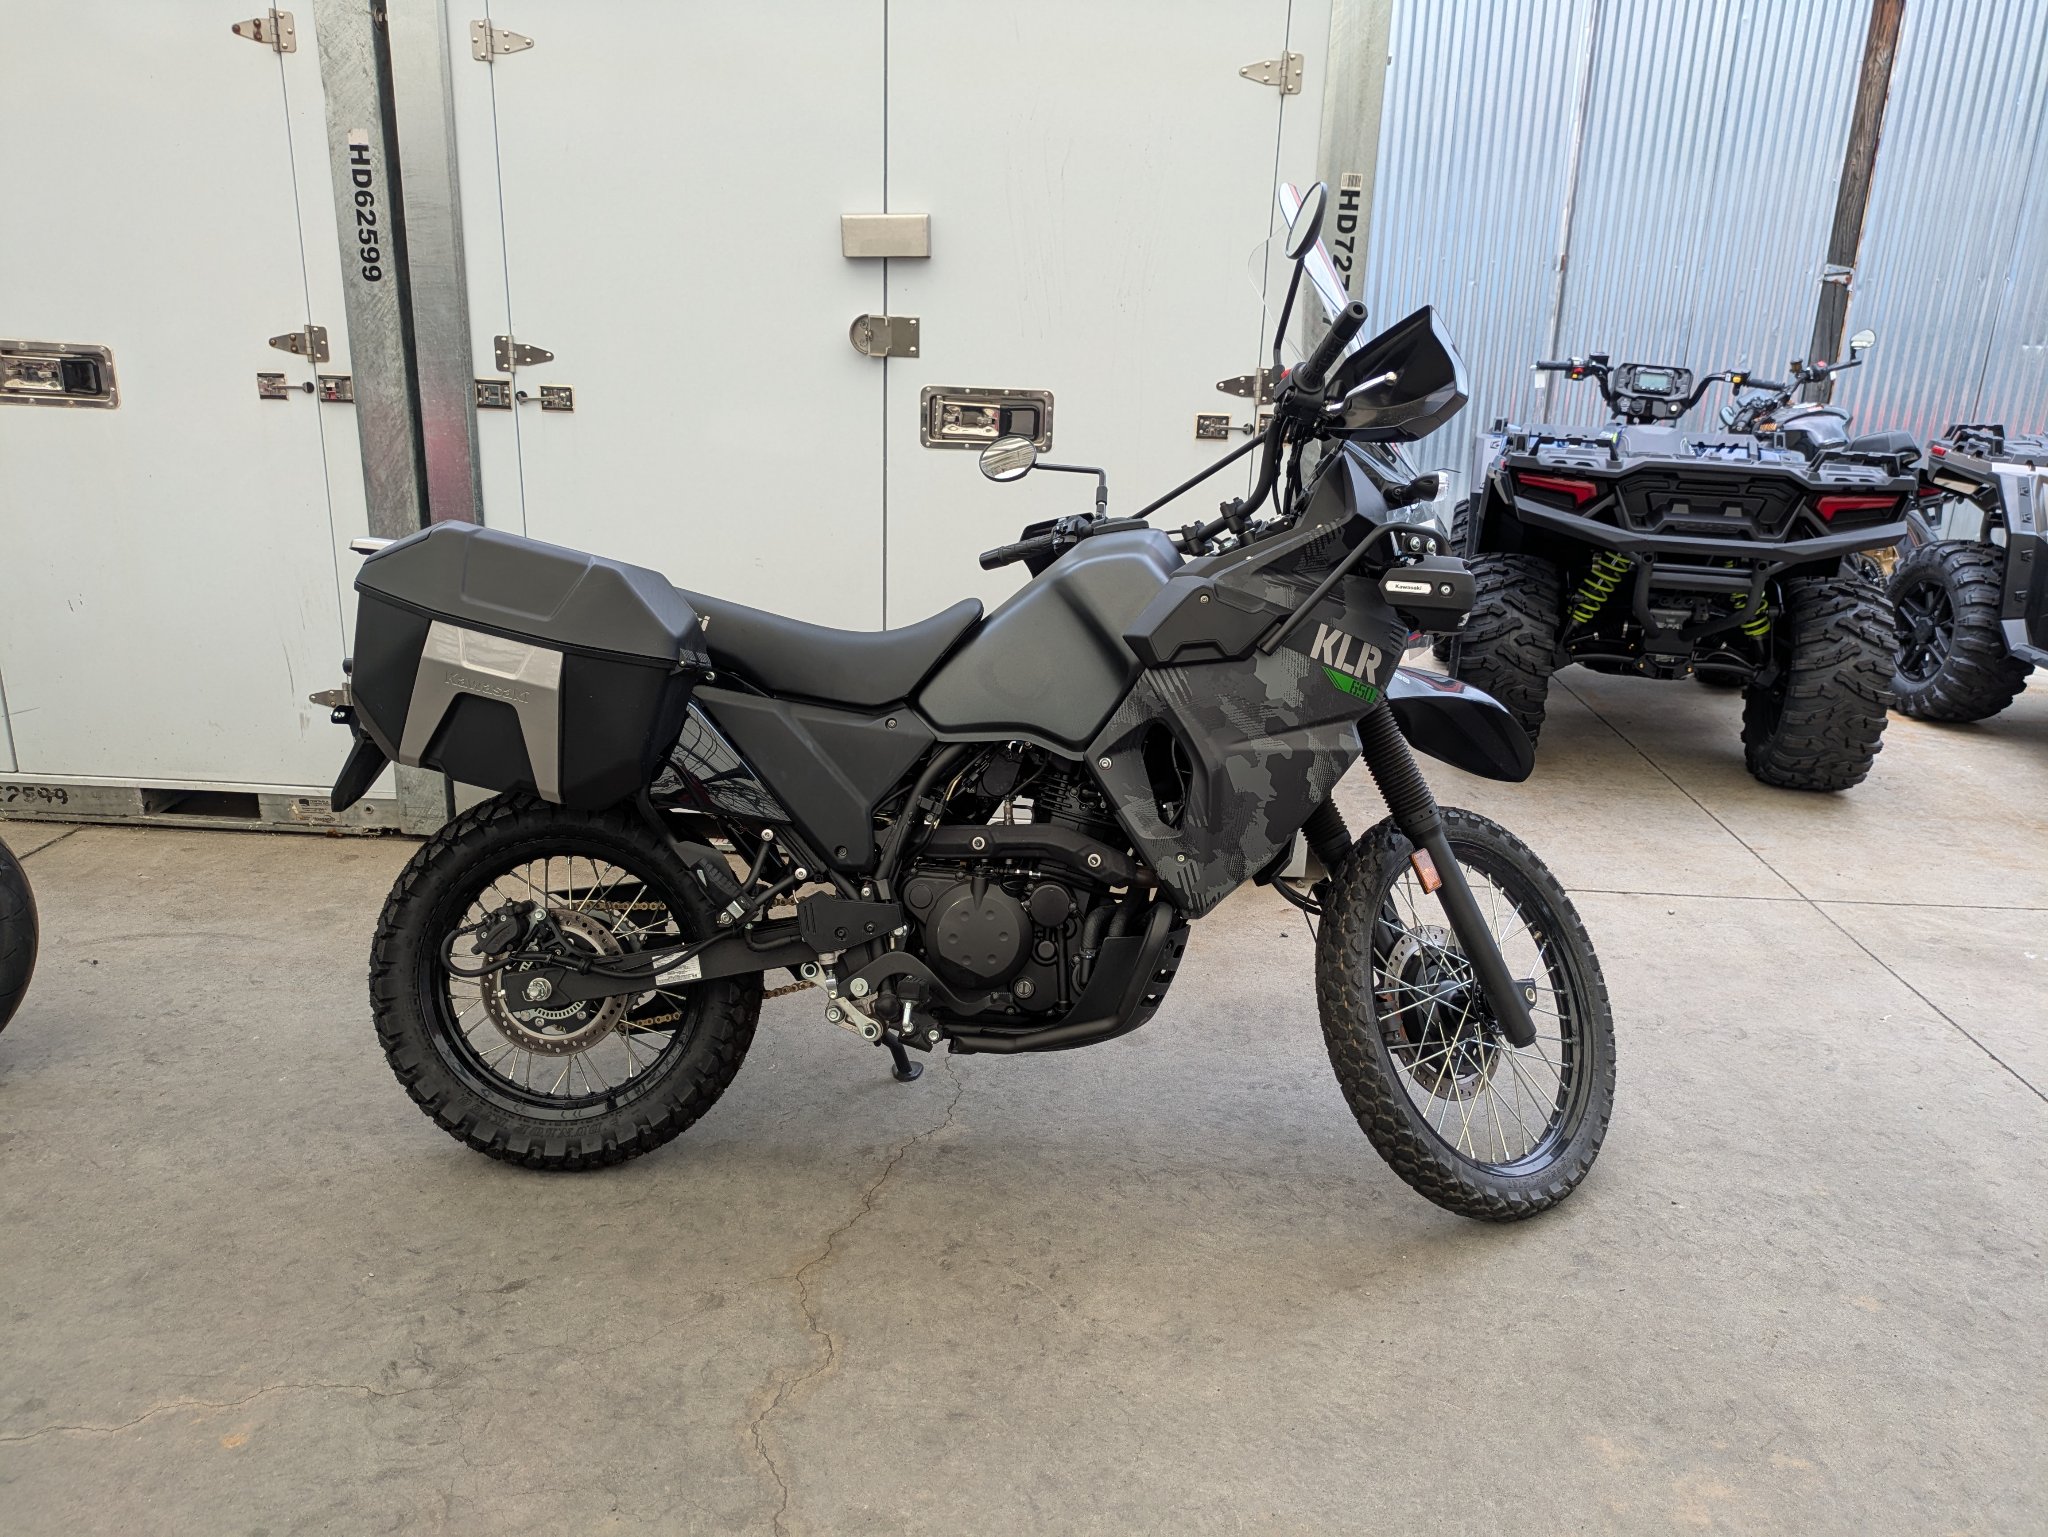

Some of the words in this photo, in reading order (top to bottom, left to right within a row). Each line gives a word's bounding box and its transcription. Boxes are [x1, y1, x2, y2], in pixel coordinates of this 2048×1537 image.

[349, 144, 382, 282] HD62599
[1394, 583, 1423, 591] Kawasaki
[1310, 623, 1382, 685] KLR
[444, 671, 530, 704] Kawasaki
[0, 785, 69, 804] 2599
